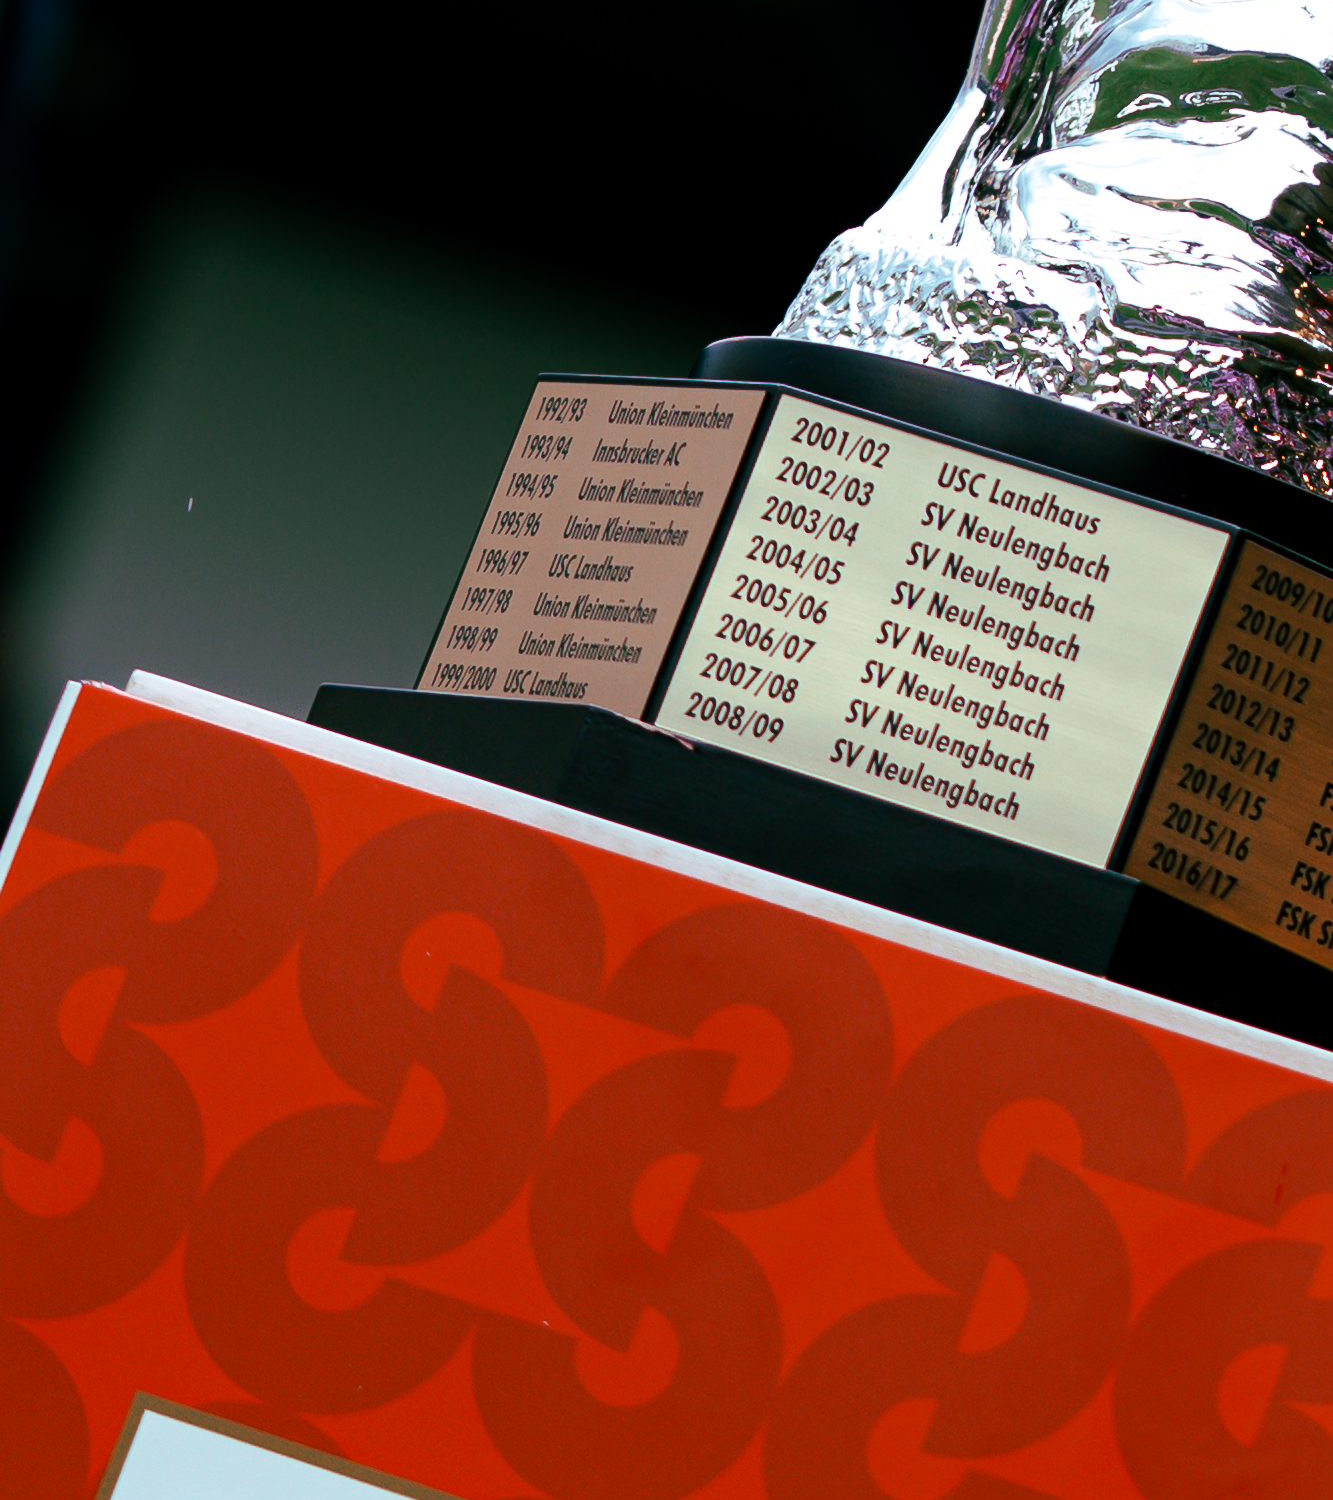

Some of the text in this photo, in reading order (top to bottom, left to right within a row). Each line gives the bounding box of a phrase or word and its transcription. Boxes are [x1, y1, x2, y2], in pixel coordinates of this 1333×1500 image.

[535, 397, 733, 429] 1992/93 Union Kleinmünchen
[521, 434, 686, 466] 1993/94 Innsbrucker AC
[791, 417, 1100, 534] 2001/02 USC Landhaus
[505, 472, 703, 506] 1994/95 Union Kleinmünchen
[491, 510, 688, 545] 1995/96 Union Kleinmünchen
[776, 457, 1109, 582] 2002/03 SV Neulengbach
[476, 548, 633, 582] 1996/97 USC Landhaus
[761, 496, 1094, 622] 2003/04 SV Neulengbach
[461, 587, 657, 623] 1997/98 Union Kleinmünchen
[746, 535, 1079, 661] 2004/05 SV Neulengbach
[446, 625, 642, 663] 1998/99 Union Kleinmünchen
[730, 574, 1064, 701] 2005/06 SV Neulengbach
[1235, 603, 1322, 663] 2010/11
[431, 663, 588, 699] 1999/2000 USC Landhaus
[715, 614, 1049, 740] 2006/07 SV Neulengbach
[1220, 643, 1310, 704] 2011/12
[700, 653, 1034, 780] 2007/08 SV Neulengbach
[1206, 683, 1295, 742] 2012/13
[684, 692, 1019, 820] 2008/09 SV Neulengbach
[1191, 722, 1280, 782] 2013/14
[1176, 762, 1266, 821] 2014/15
[1161, 802, 1250, 861] 2015/16
[1290, 861, 1331, 900] FSK
[1147, 841, 1238, 901] 2016/17
[1275, 900, 1317, 940] FSK
